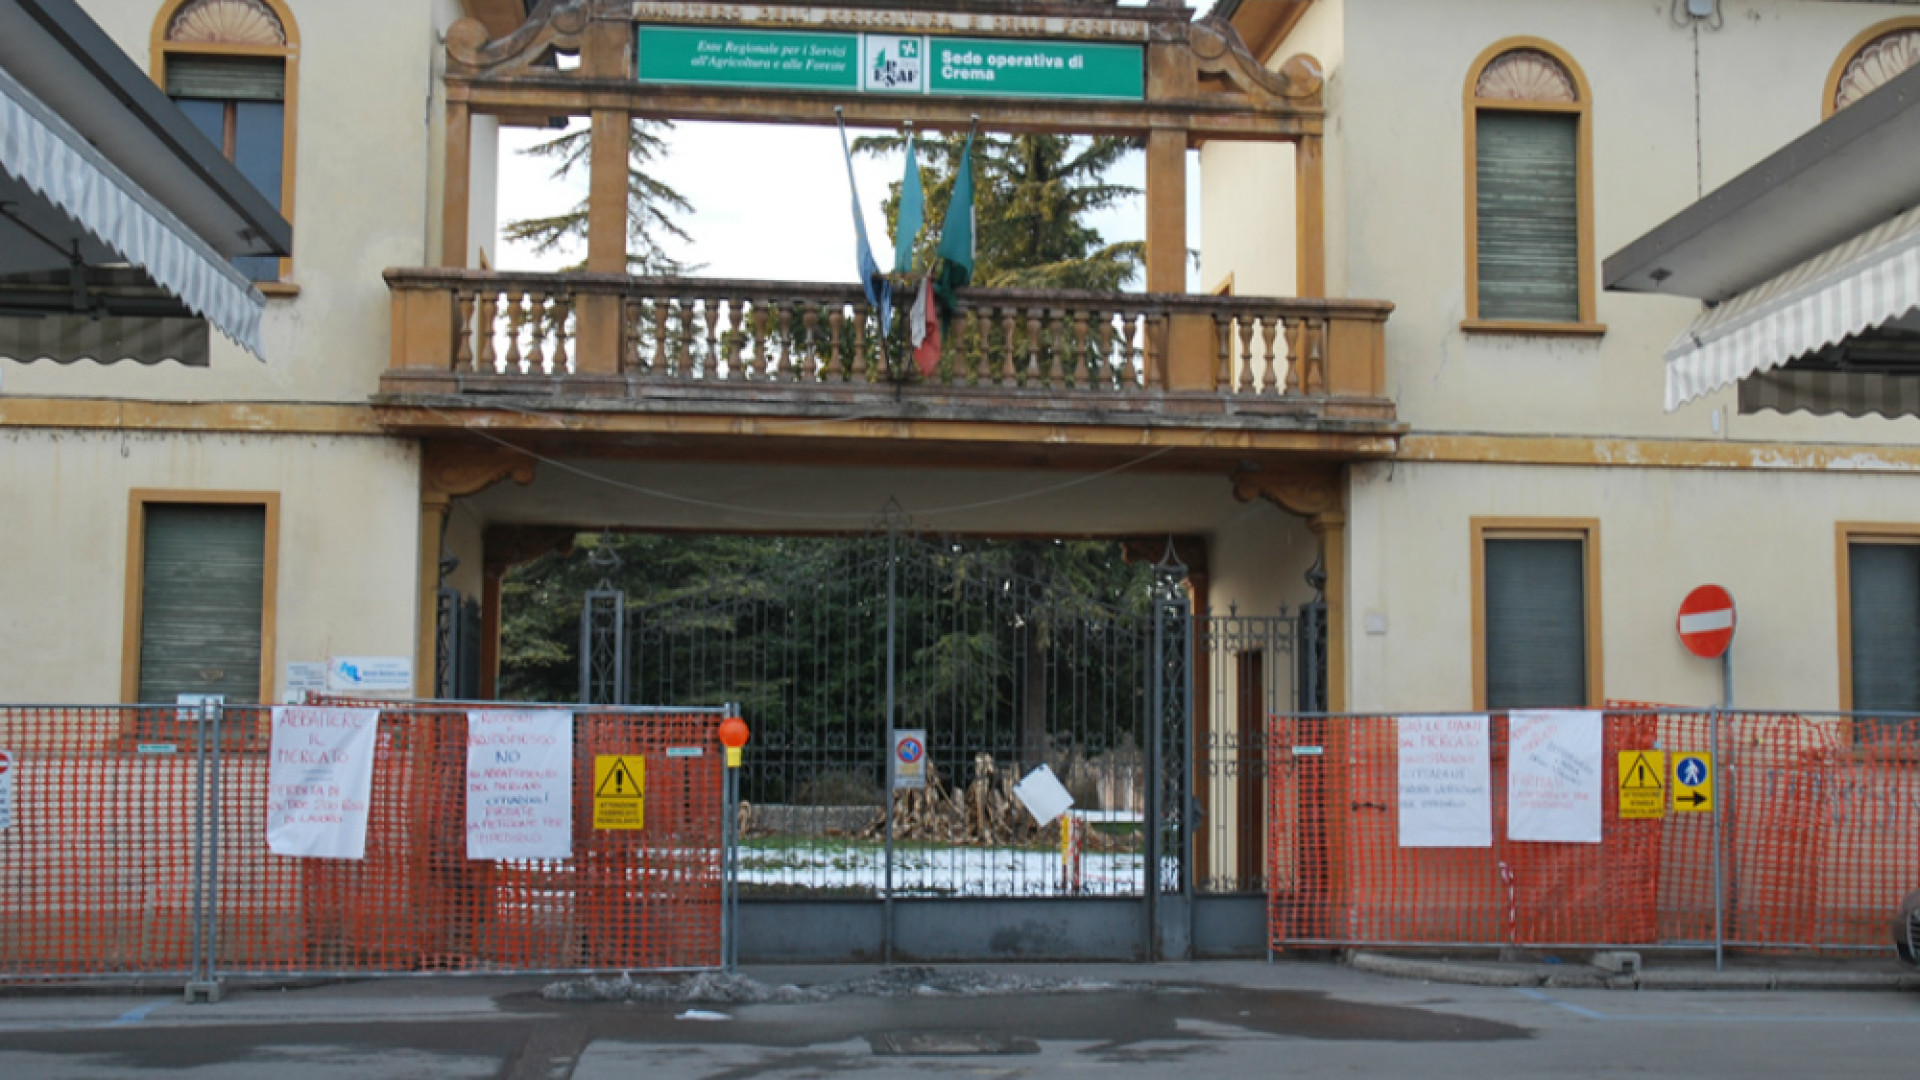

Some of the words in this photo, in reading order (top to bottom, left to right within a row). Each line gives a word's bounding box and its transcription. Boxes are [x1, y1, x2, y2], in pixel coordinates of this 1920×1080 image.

[697, 40, 722, 53] Ente
[725, 41, 778, 55] Regionale
[781, 46, 800, 57] per
[809, 44, 847, 58] Servizi
[690, 55, 770, 69] all'Agricoltura
[783, 58, 803, 69] alle
[806, 59, 846, 71] Foreste
[942, 49, 982, 66] Sede
[987, 52, 1065, 69] operativa
[1069, 54, 1084, 69] di
[942, 65, 995, 80] Crema
[1421, 734, 1479, 748] MERCATO
[278, 747, 350, 764] MERCATO
[495, 749, 521, 763] NO
